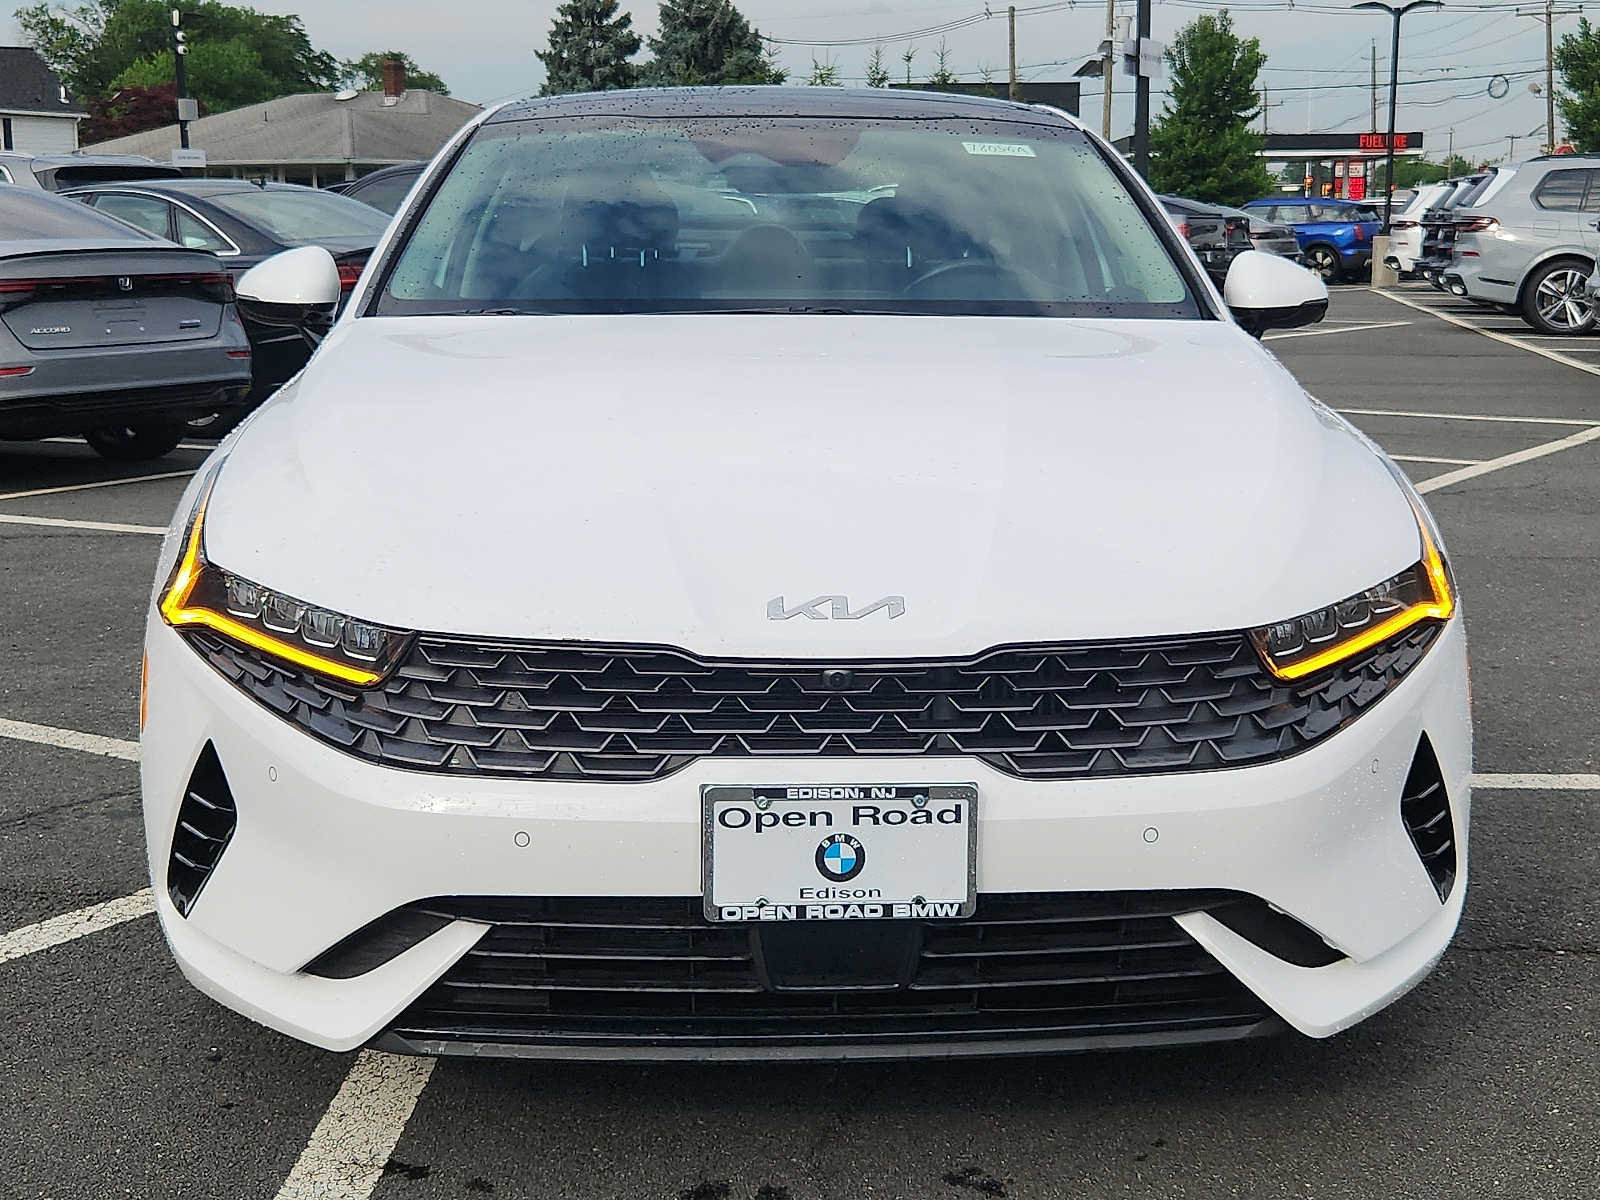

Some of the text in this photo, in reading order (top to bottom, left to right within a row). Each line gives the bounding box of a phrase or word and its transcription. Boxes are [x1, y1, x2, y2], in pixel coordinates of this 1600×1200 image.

[1360, 135, 1384, 148] FUEL
[30, 326, 71, 335] ACCORD
[767, 595, 905, 620] KIA
[786, 788, 896, 800] EDISON, NJ
[718, 804, 962, 833] Open Road
[821, 834, 861, 850] BMW
[799, 887, 881, 900] Edison
[721, 903, 959, 921] OPEN ROAD BMW
